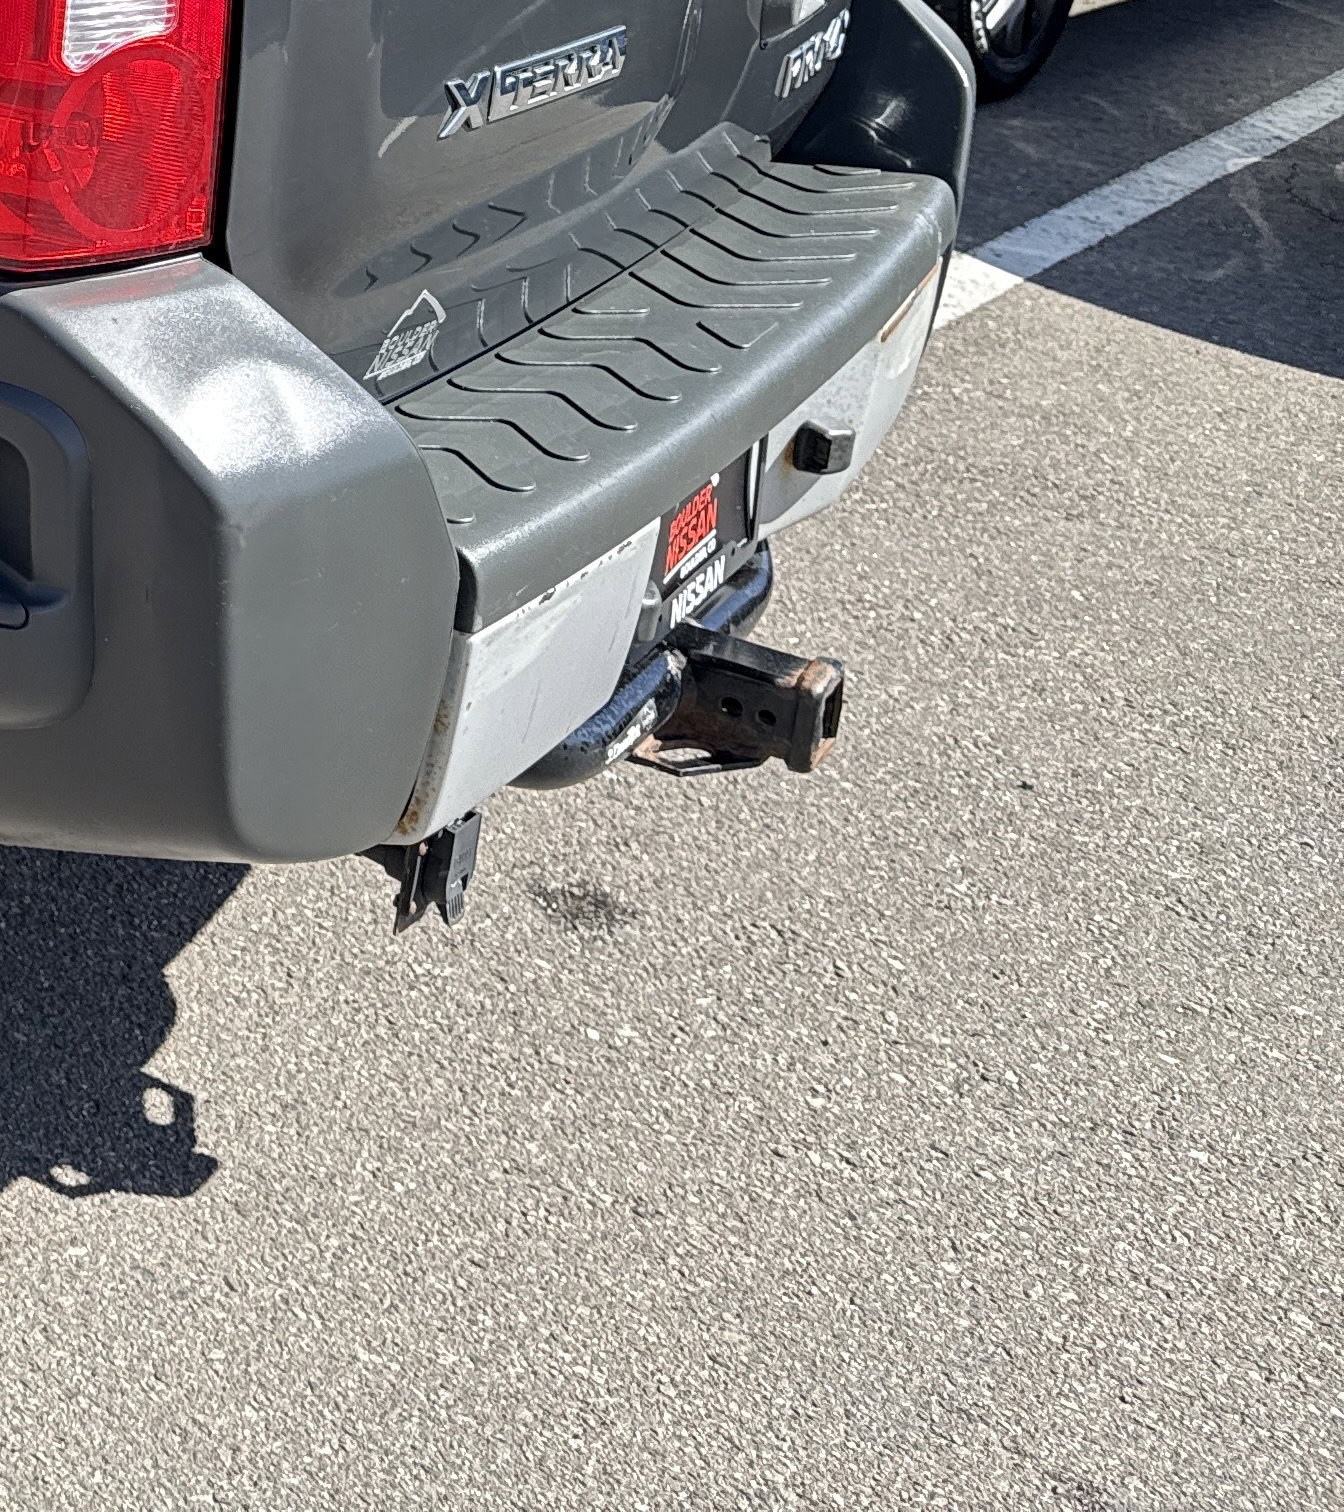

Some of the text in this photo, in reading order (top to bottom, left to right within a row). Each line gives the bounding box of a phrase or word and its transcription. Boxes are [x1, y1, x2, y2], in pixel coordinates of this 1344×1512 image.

[437, 25, 626, 140] XTERRA
[365, 330, 440, 375] NISSAN
[379, 319, 437, 353] BOULDER
[665, 497, 718, 575] NISSAN
[669, 484, 713, 542] BOULDER
[670, 555, 726, 629] NISSAN
